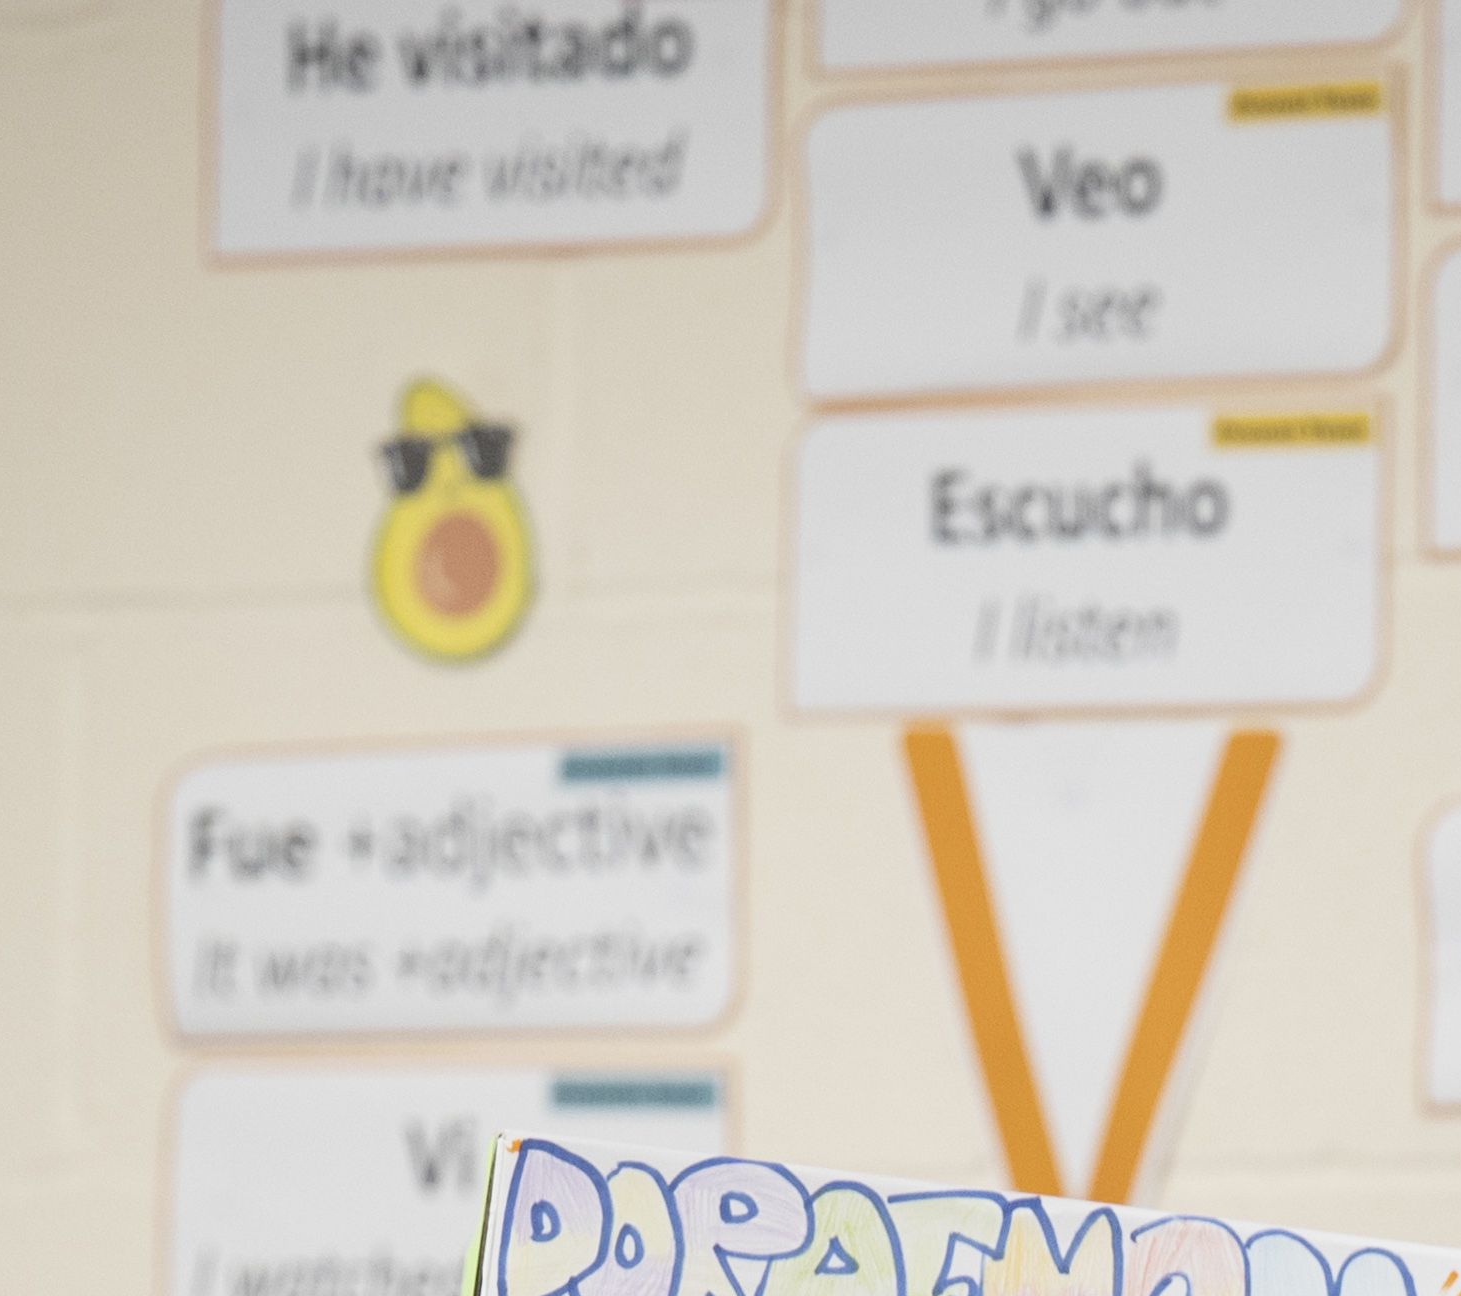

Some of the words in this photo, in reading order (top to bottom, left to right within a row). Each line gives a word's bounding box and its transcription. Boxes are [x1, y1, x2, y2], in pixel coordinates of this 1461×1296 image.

[287, 20, 382, 95] He
[401, 2, 696, 88] visitado
[1016, 145, 1164, 220] Veo
[927, 462, 1231, 546] Escucho
[187, 803, 321, 884] Fue
